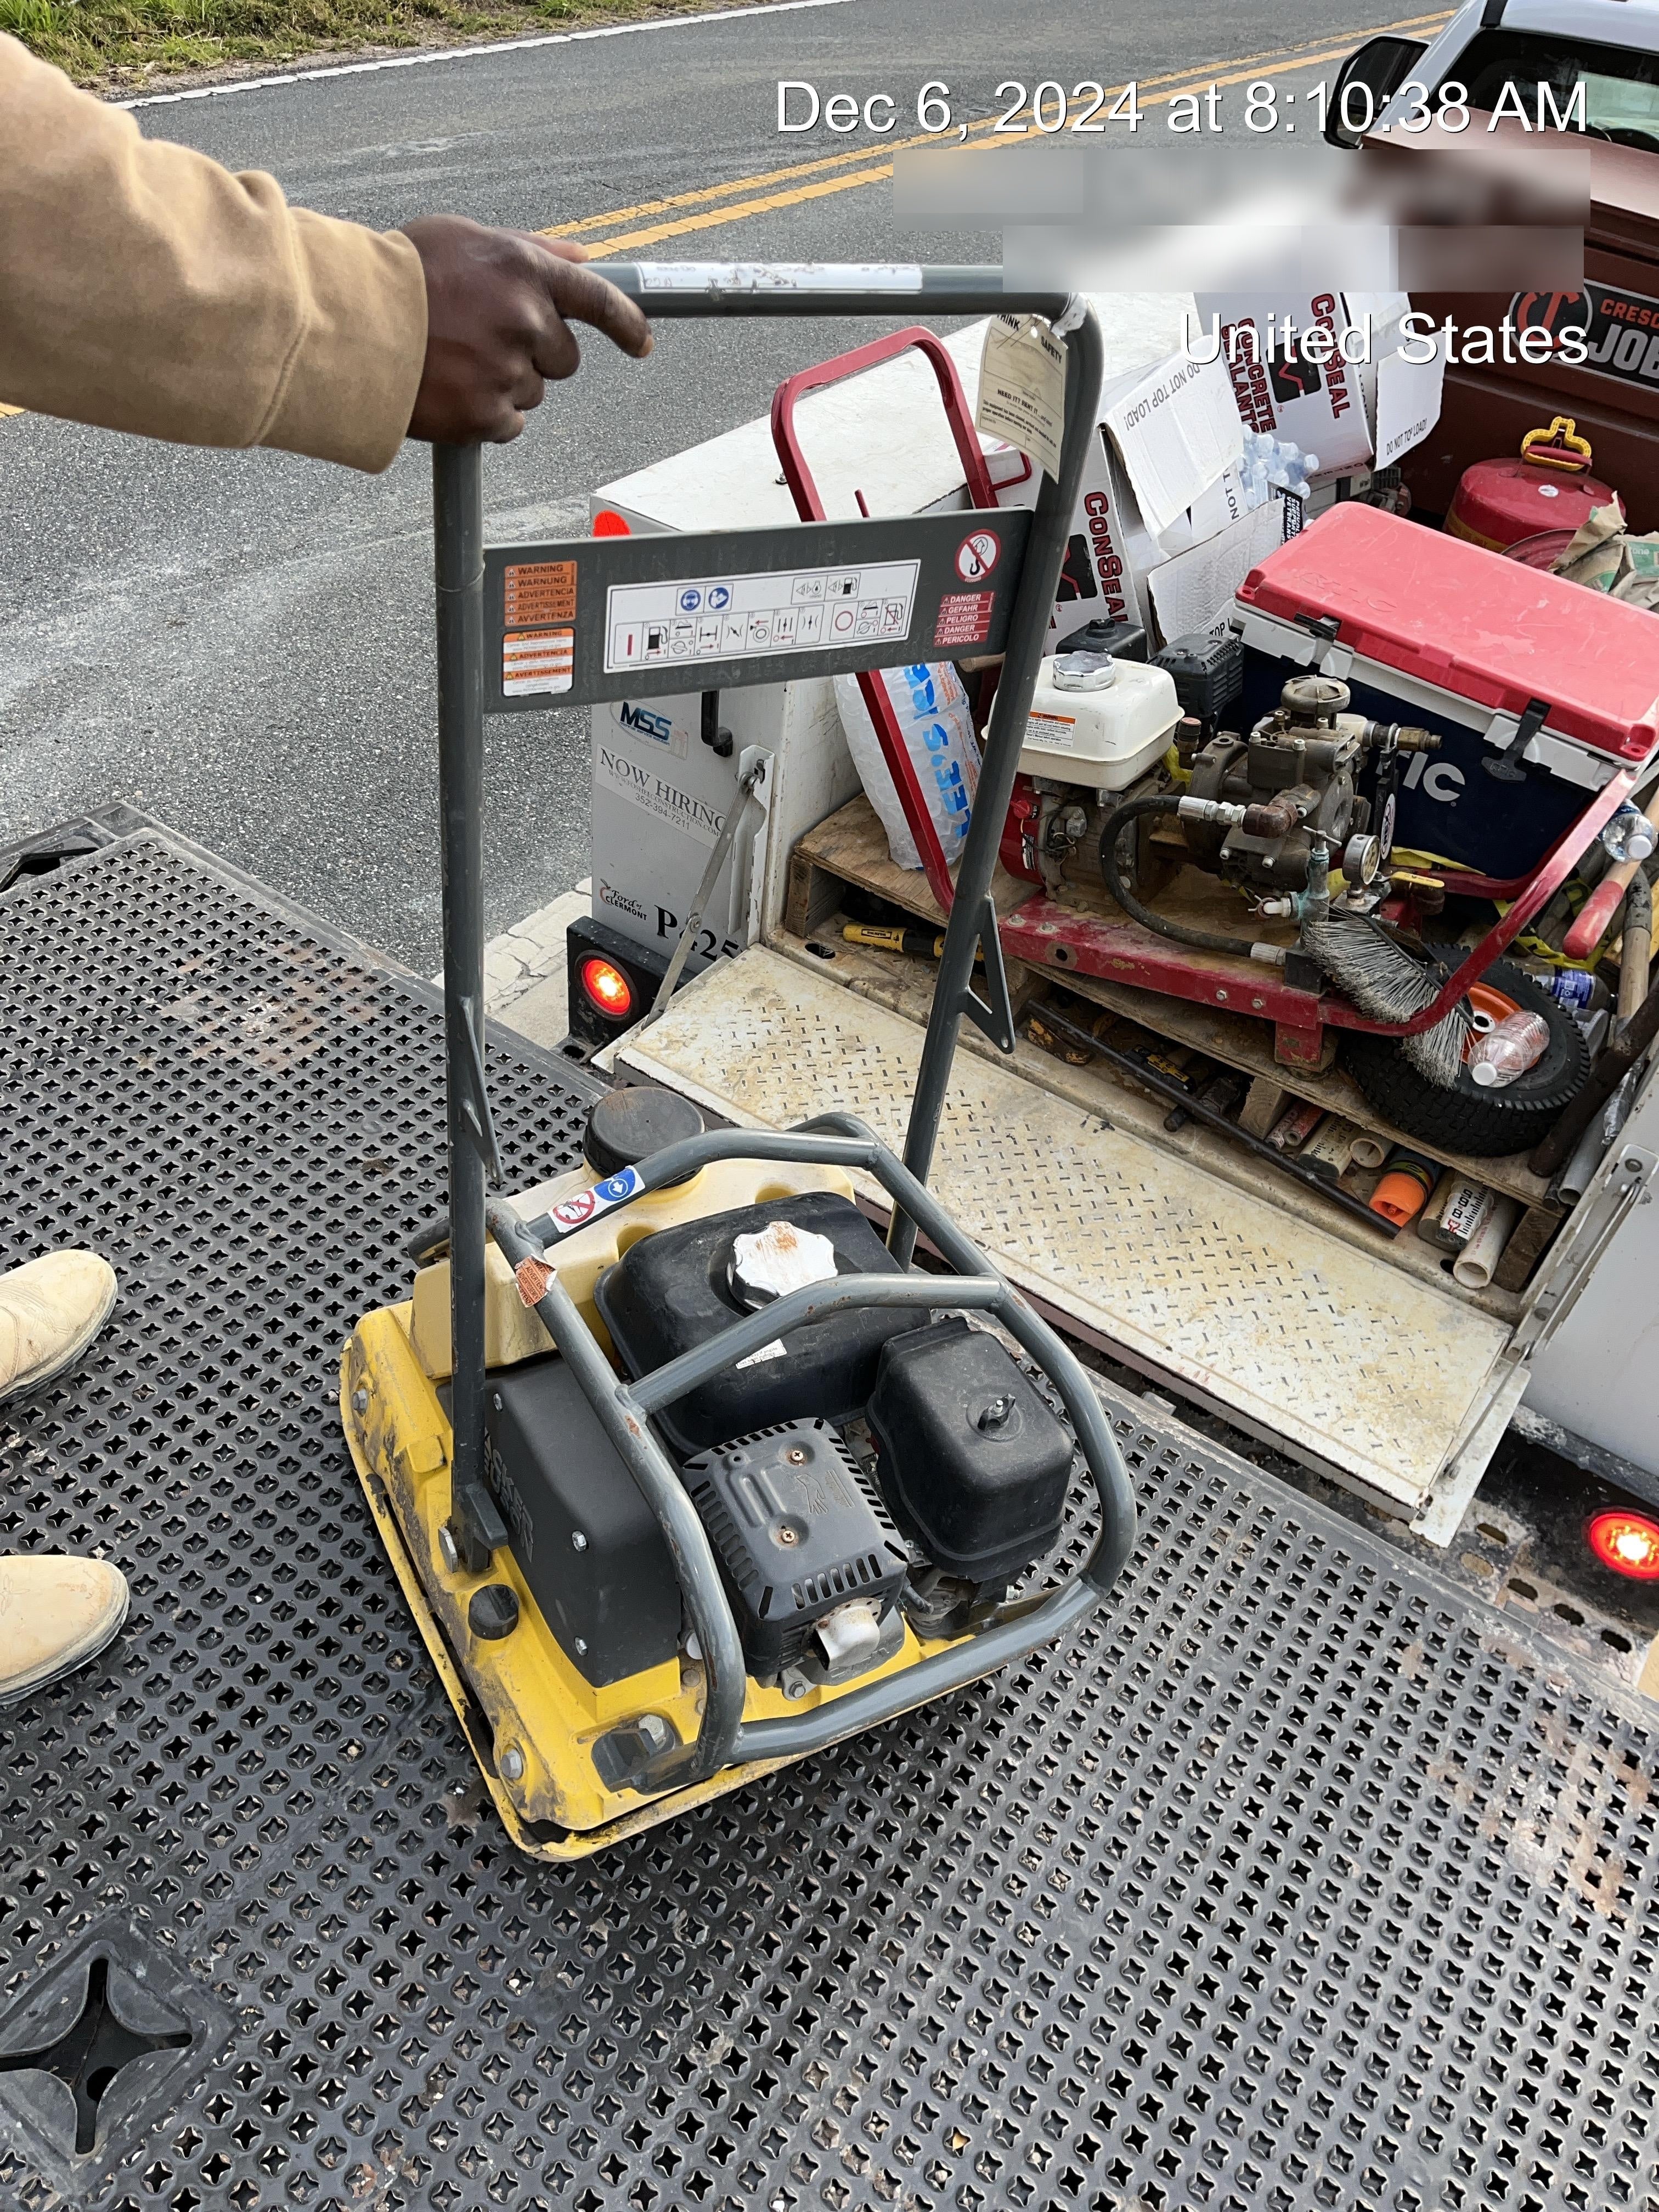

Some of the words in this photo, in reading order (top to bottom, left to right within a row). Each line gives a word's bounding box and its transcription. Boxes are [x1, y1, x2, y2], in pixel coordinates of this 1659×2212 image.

[1041, 336, 1062, 363] SAFETY
[1169, 369, 1187, 394] NOT
[997, 388, 1012, 400] NEED
[1012, 396, 1021, 404] IT?
[1152, 384, 1170, 408] TOP
[1124, 398, 1152, 432] LOAD!
[1225, 487, 1240, 520] NOT
[518, 565, 563, 575] WARNING
[518, 575, 567, 587] WARNUNG
[518, 588, 574, 599] ADVERTENCIA
[950, 594, 981, 603] DANGER
[518, 611, 573, 623] AVVERTENZA
[948, 604, 979, 614] GEFAHR
[946, 614, 979, 624] PELIGRO
[944, 624, 975, 634] DANGER
[942, 633, 979, 645] PERICOLO
[620, 701, 672, 741] MSS
[600, 748, 651, 787] NOW
[635, 793, 690, 830] 352-394-7211
[605, 895, 647, 921] CLERMONT
[612, 889, 637, 909] Ford
